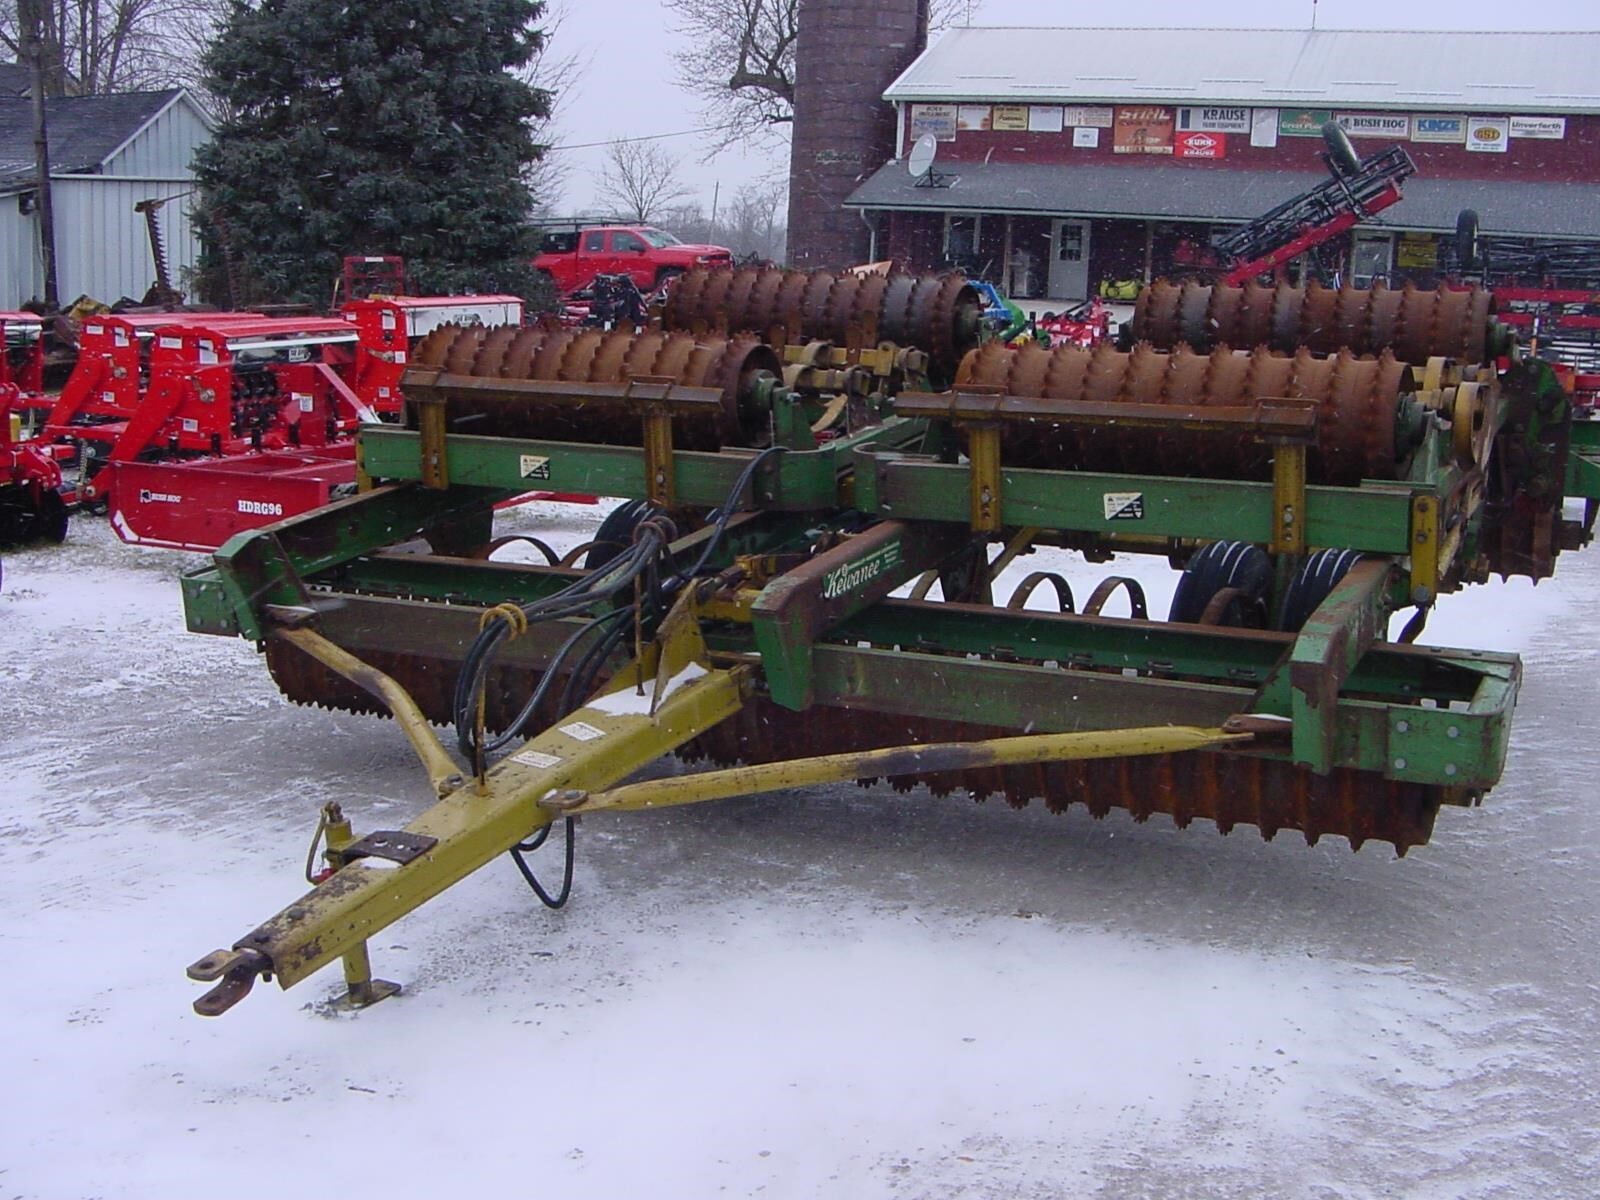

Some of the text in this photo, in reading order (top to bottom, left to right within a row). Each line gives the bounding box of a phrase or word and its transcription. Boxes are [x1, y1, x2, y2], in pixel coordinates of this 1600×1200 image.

[1119, 109, 1170, 120] STIHL
[1203, 109, 1246, 121] KRAUSE
[1353, 118, 1406, 129] BUSH HOG
[1418, 119, 1460, 132] KINZE
[238, 500, 283, 516] HDRG96
